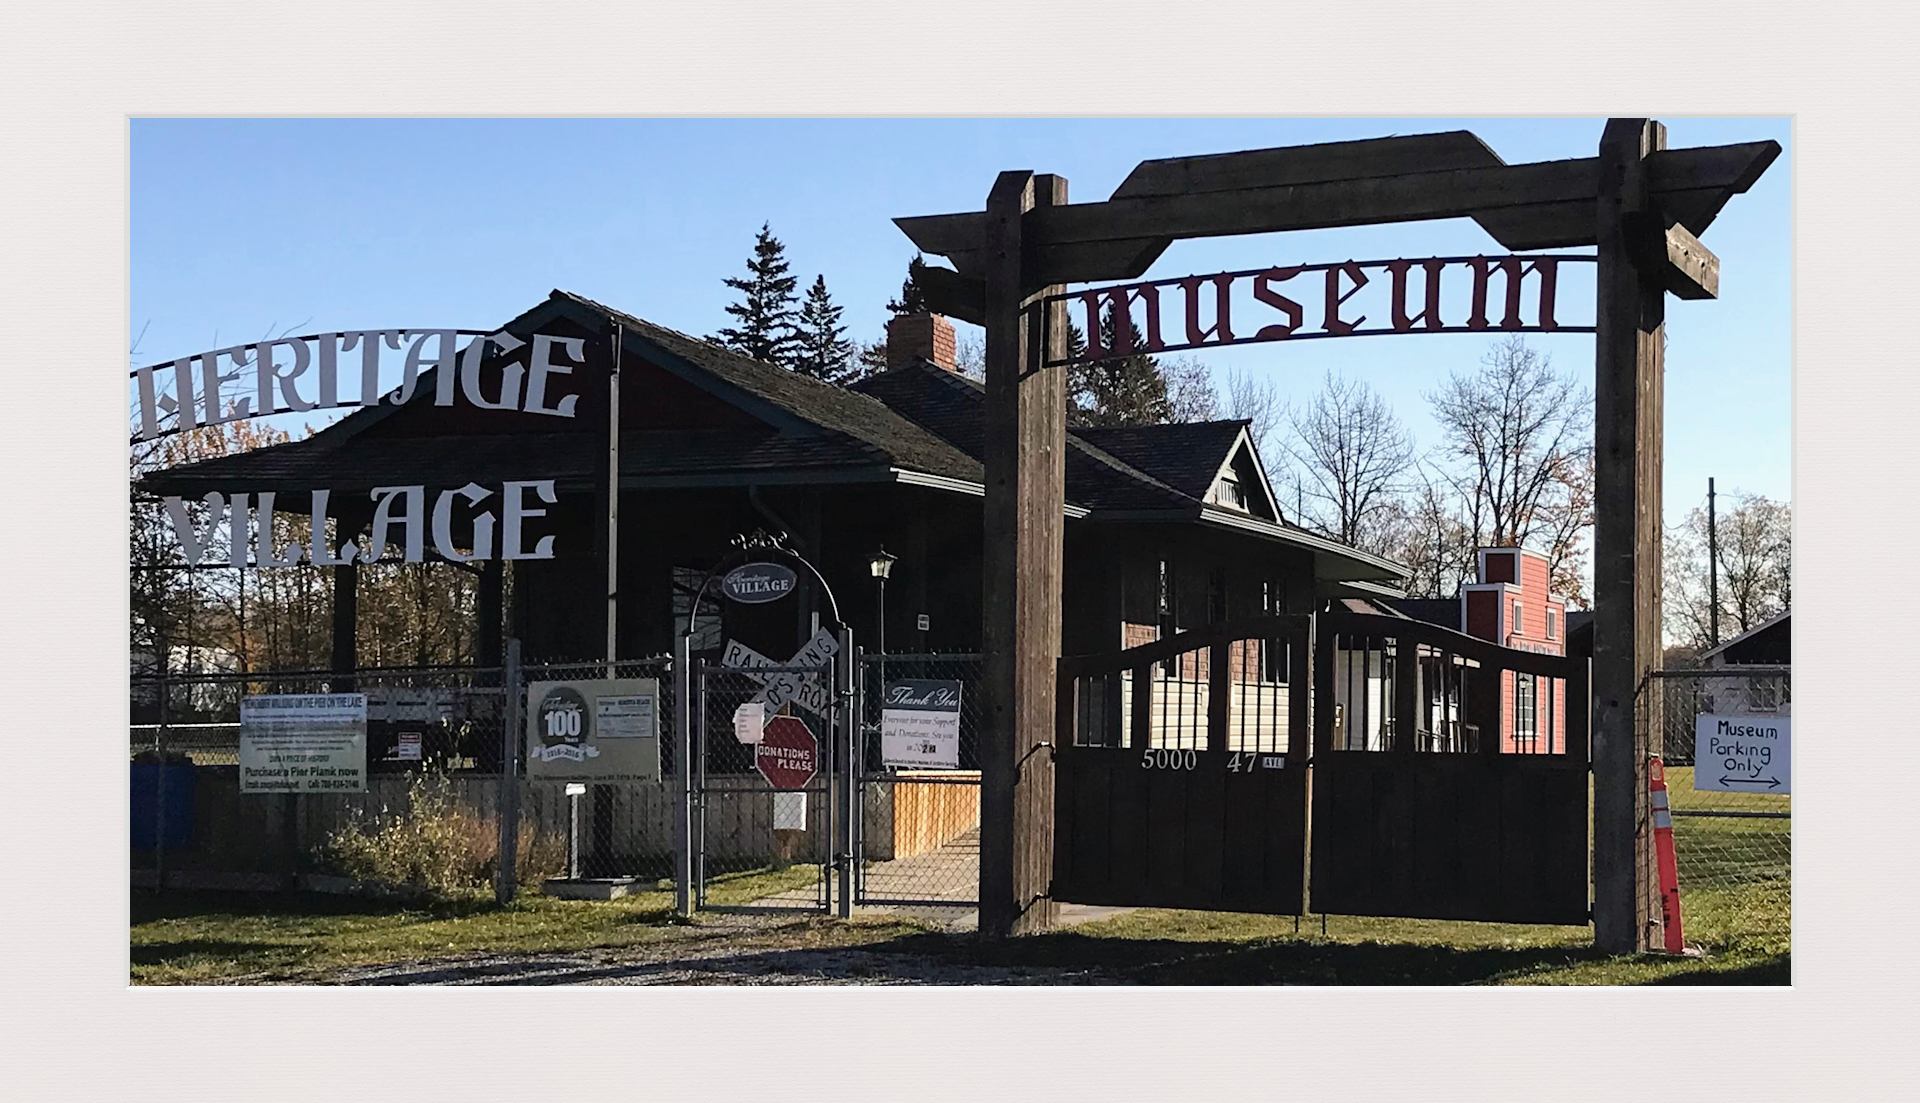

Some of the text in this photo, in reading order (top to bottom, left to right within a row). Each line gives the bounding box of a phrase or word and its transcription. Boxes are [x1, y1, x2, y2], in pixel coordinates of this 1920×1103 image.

[1078, 253, 1559, 359] museum
[137, 328, 586, 440] HERITAGE
[163, 480, 557, 570] VILLAGE
[732, 580, 789, 594] VILLAGE
[885, 686, 958, 707] Thank You
[544, 711, 581, 737] 100
[1717, 720, 1778, 739] Museum
[758, 745, 810, 761] DONATIONS
[1141, 749, 1197, 771] 5000
[1710, 737, 1771, 765] Parking
[245, 766, 281, 777] Purchase
[291, 766, 308, 777] Pier
[310, 766, 336, 777] Plank
[338, 768, 359, 777] now
[777, 759, 813, 772] PLEASE
[1226, 751, 1257, 773] 47
[1724, 758, 1763, 778] Only
